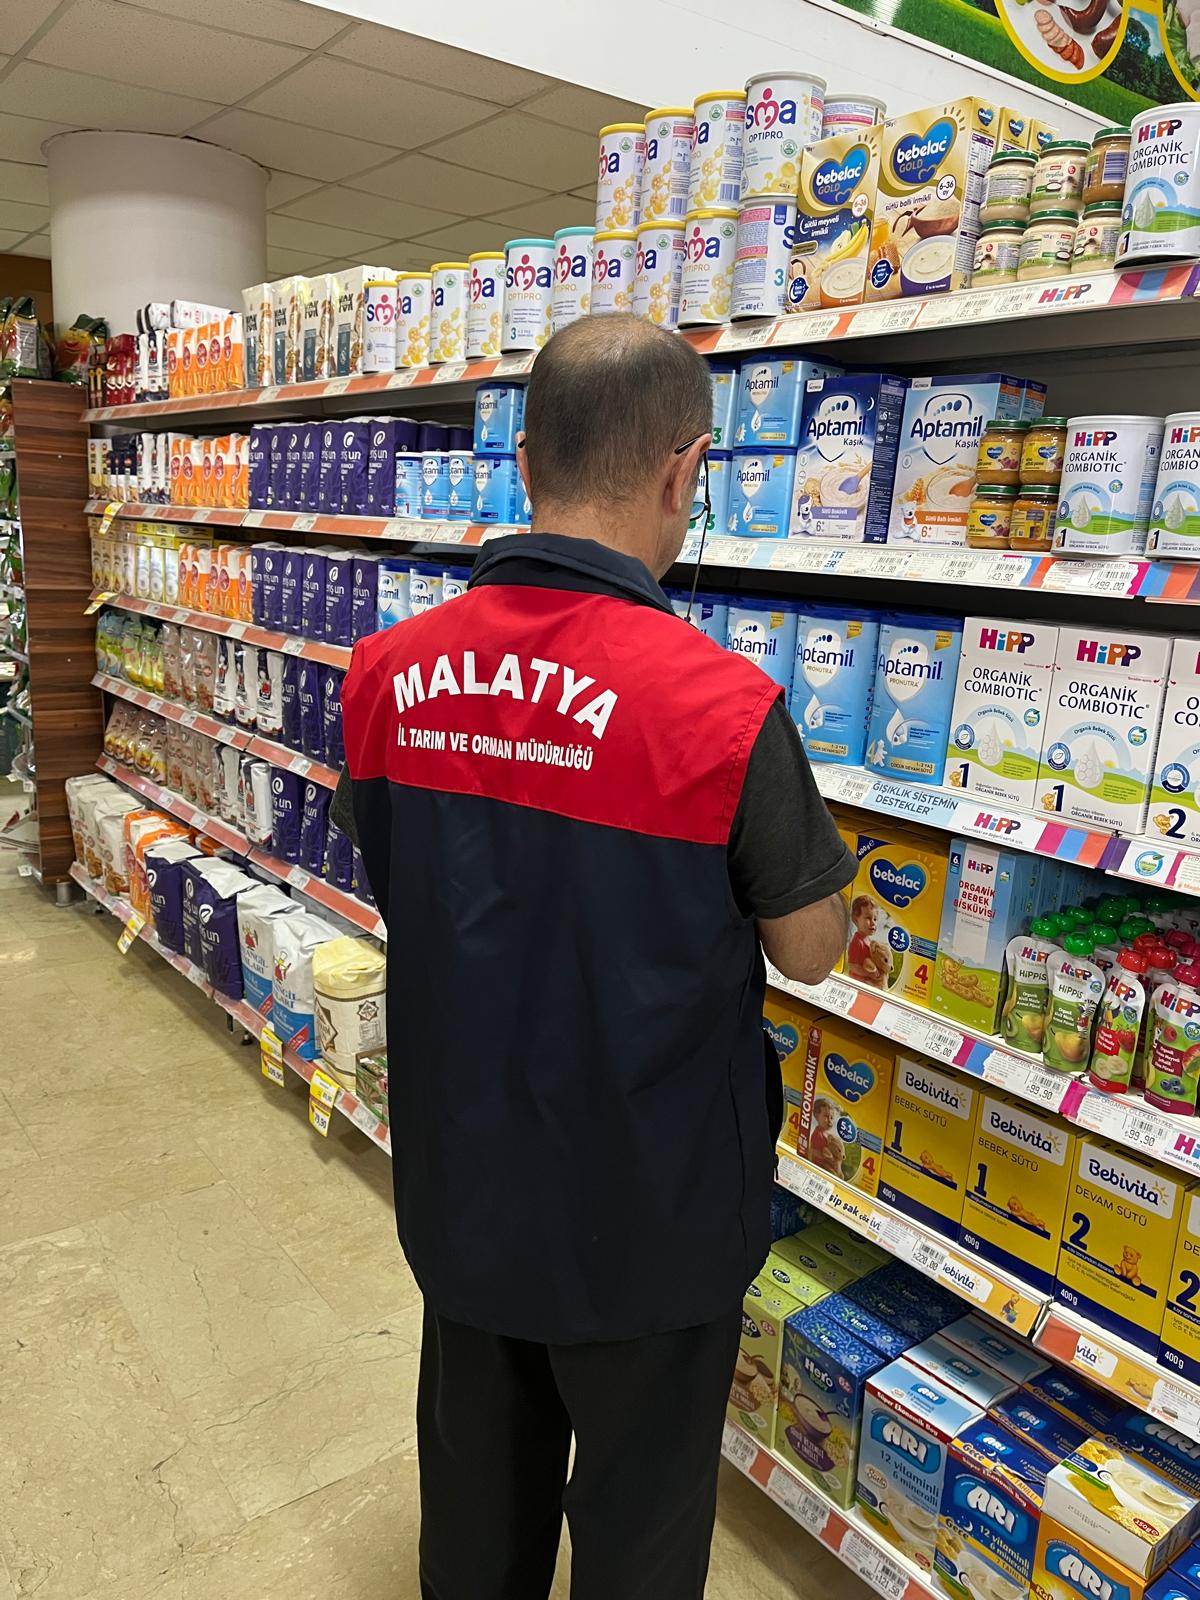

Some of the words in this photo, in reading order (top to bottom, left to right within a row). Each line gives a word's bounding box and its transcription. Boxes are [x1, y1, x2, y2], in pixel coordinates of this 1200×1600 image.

[746, 87, 797, 130] sma
[749, 131, 783, 143] OPTIPRO
[1137, 119, 1183, 143] HiPP
[896, 137, 947, 163] bebelac
[1132, 140, 1183, 161] ORGANİK
[900, 160, 923, 173] GOLD
[1128, 152, 1189, 175] COMBIOTIC
[816, 165, 862, 186] bebelac
[818, 183, 840, 195] GOLD
[505, 254, 551, 291] sma
[774, 268, 785, 287] 3
[1038, 283, 1092, 304] HiPP
[745, 376, 779, 392] Aptamil
[712, 428, 722, 444] 3
[807, 415, 866, 440] Aptamil
[910, 415, 983, 442] Aptamil
[1170, 427, 1200, 444] HiP
[843, 438, 864, 446] Kaşık
[955, 438, 979, 449] Kaşık
[1074, 431, 1117, 448] HiPP
[1069, 451, 1118, 463] ORGANİK
[1160, 460, 1199, 472] COMBIO
[1165, 449, 1200, 460] ORGAN
[737, 469, 770, 485] Aptamil
[1064, 461, 1123, 474] COMBIOTIC
[727, 633, 778, 656] Aptamil
[979, 628, 1035, 654] HiPP
[796, 642, 855, 668] Aptamil
[1076, 639, 1141, 667] HiPP
[877, 654, 943, 681] Aptamil
[972, 667, 1033, 687] ORGANİK
[393, 651, 619, 740] MALATYA
[963, 679, 1039, 702] COMBIOTIC
[1068, 681, 1138, 703] ORGANİK
[1058, 694, 1145, 719] COMBIOTIC
[397, 722, 406, 746] İL
[409, 728, 446, 750] TARIM
[449, 732, 468, 752] VE
[471, 734, 512, 760] ORMAN
[515, 739, 594, 771] MÜDÜRLÜĞÜ
[959, 762, 970, 788] 1
[912, 791, 959, 810] SİSTEMİN
[1052, 784, 1065, 812] 1
[974, 812, 1022, 834] HiPP
[1071, 810, 1093, 819] ORGANİK
[1093, 814, 1109, 823] BEBEK
[1109, 818, 1123, 827] SÜTÜ
[1166, 808, 1187, 839] 2
[873, 865, 921, 891] bebelac
[967, 860, 994, 875] HiPP
[958, 880, 997, 898] ORGANİK
[961, 891, 989, 907] BEBEK
[914, 964, 929, 985] 4
[1060, 962, 1092, 982] HiPP
[1107, 975, 1137, 1002] HPP
[827, 1057, 870, 1090] bebelac
[800, 1050, 818, 1129] EKONOMİK
[905, 1071, 959, 1110] Bebivita
[894, 1095, 921, 1114] BEBEK
[923, 1108, 947, 1128] SÜTÜ
[890, 1119, 903, 1153] 1
[990, 1111, 1053, 1154] Bebivita
[862, 1156, 876, 1176] 4
[978, 1137, 1009, 1159] BEBEK
[1011, 1152, 1039, 1173] SÜTÜ
[974, 1162, 987, 1198] 1
[1088, 1158, 1159, 1206] Bebivita
[1075, 1184, 1114, 1211] DEVAM
[1116, 1204, 1148, 1227] SÜTÜ
[1069, 1211, 1091, 1251] 2
[942, 1262, 975, 1290] ebivita
[1175, 1270, 1200, 1313] 2
[850, 1317, 869, 1331] Hero
[820, 1334, 837, 1349] Hero
[805, 1358, 834, 1388] Hero
[917, 1386, 940, 1401] ARI
[1017, 1409, 1041, 1427] ARI
[882, 1421, 927, 1464] ARI
[962, 1442, 985, 1461] Gece
[982, 1436, 1007, 1452] ARI
[880, 1450, 892, 1465] 12
[893, 1458, 941, 1498] vitaminli
[899, 1480, 939, 1508] mineralli
[967, 1485, 1016, 1533] ARI
[945, 1516, 969, 1539] Gece
[979, 1524, 991, 1538] 12
[991, 1535, 1031, 1570] vitaminli
[996, 1547, 1029, 1577] mineralli
[1058, 1553, 1113, 1600] ARI
